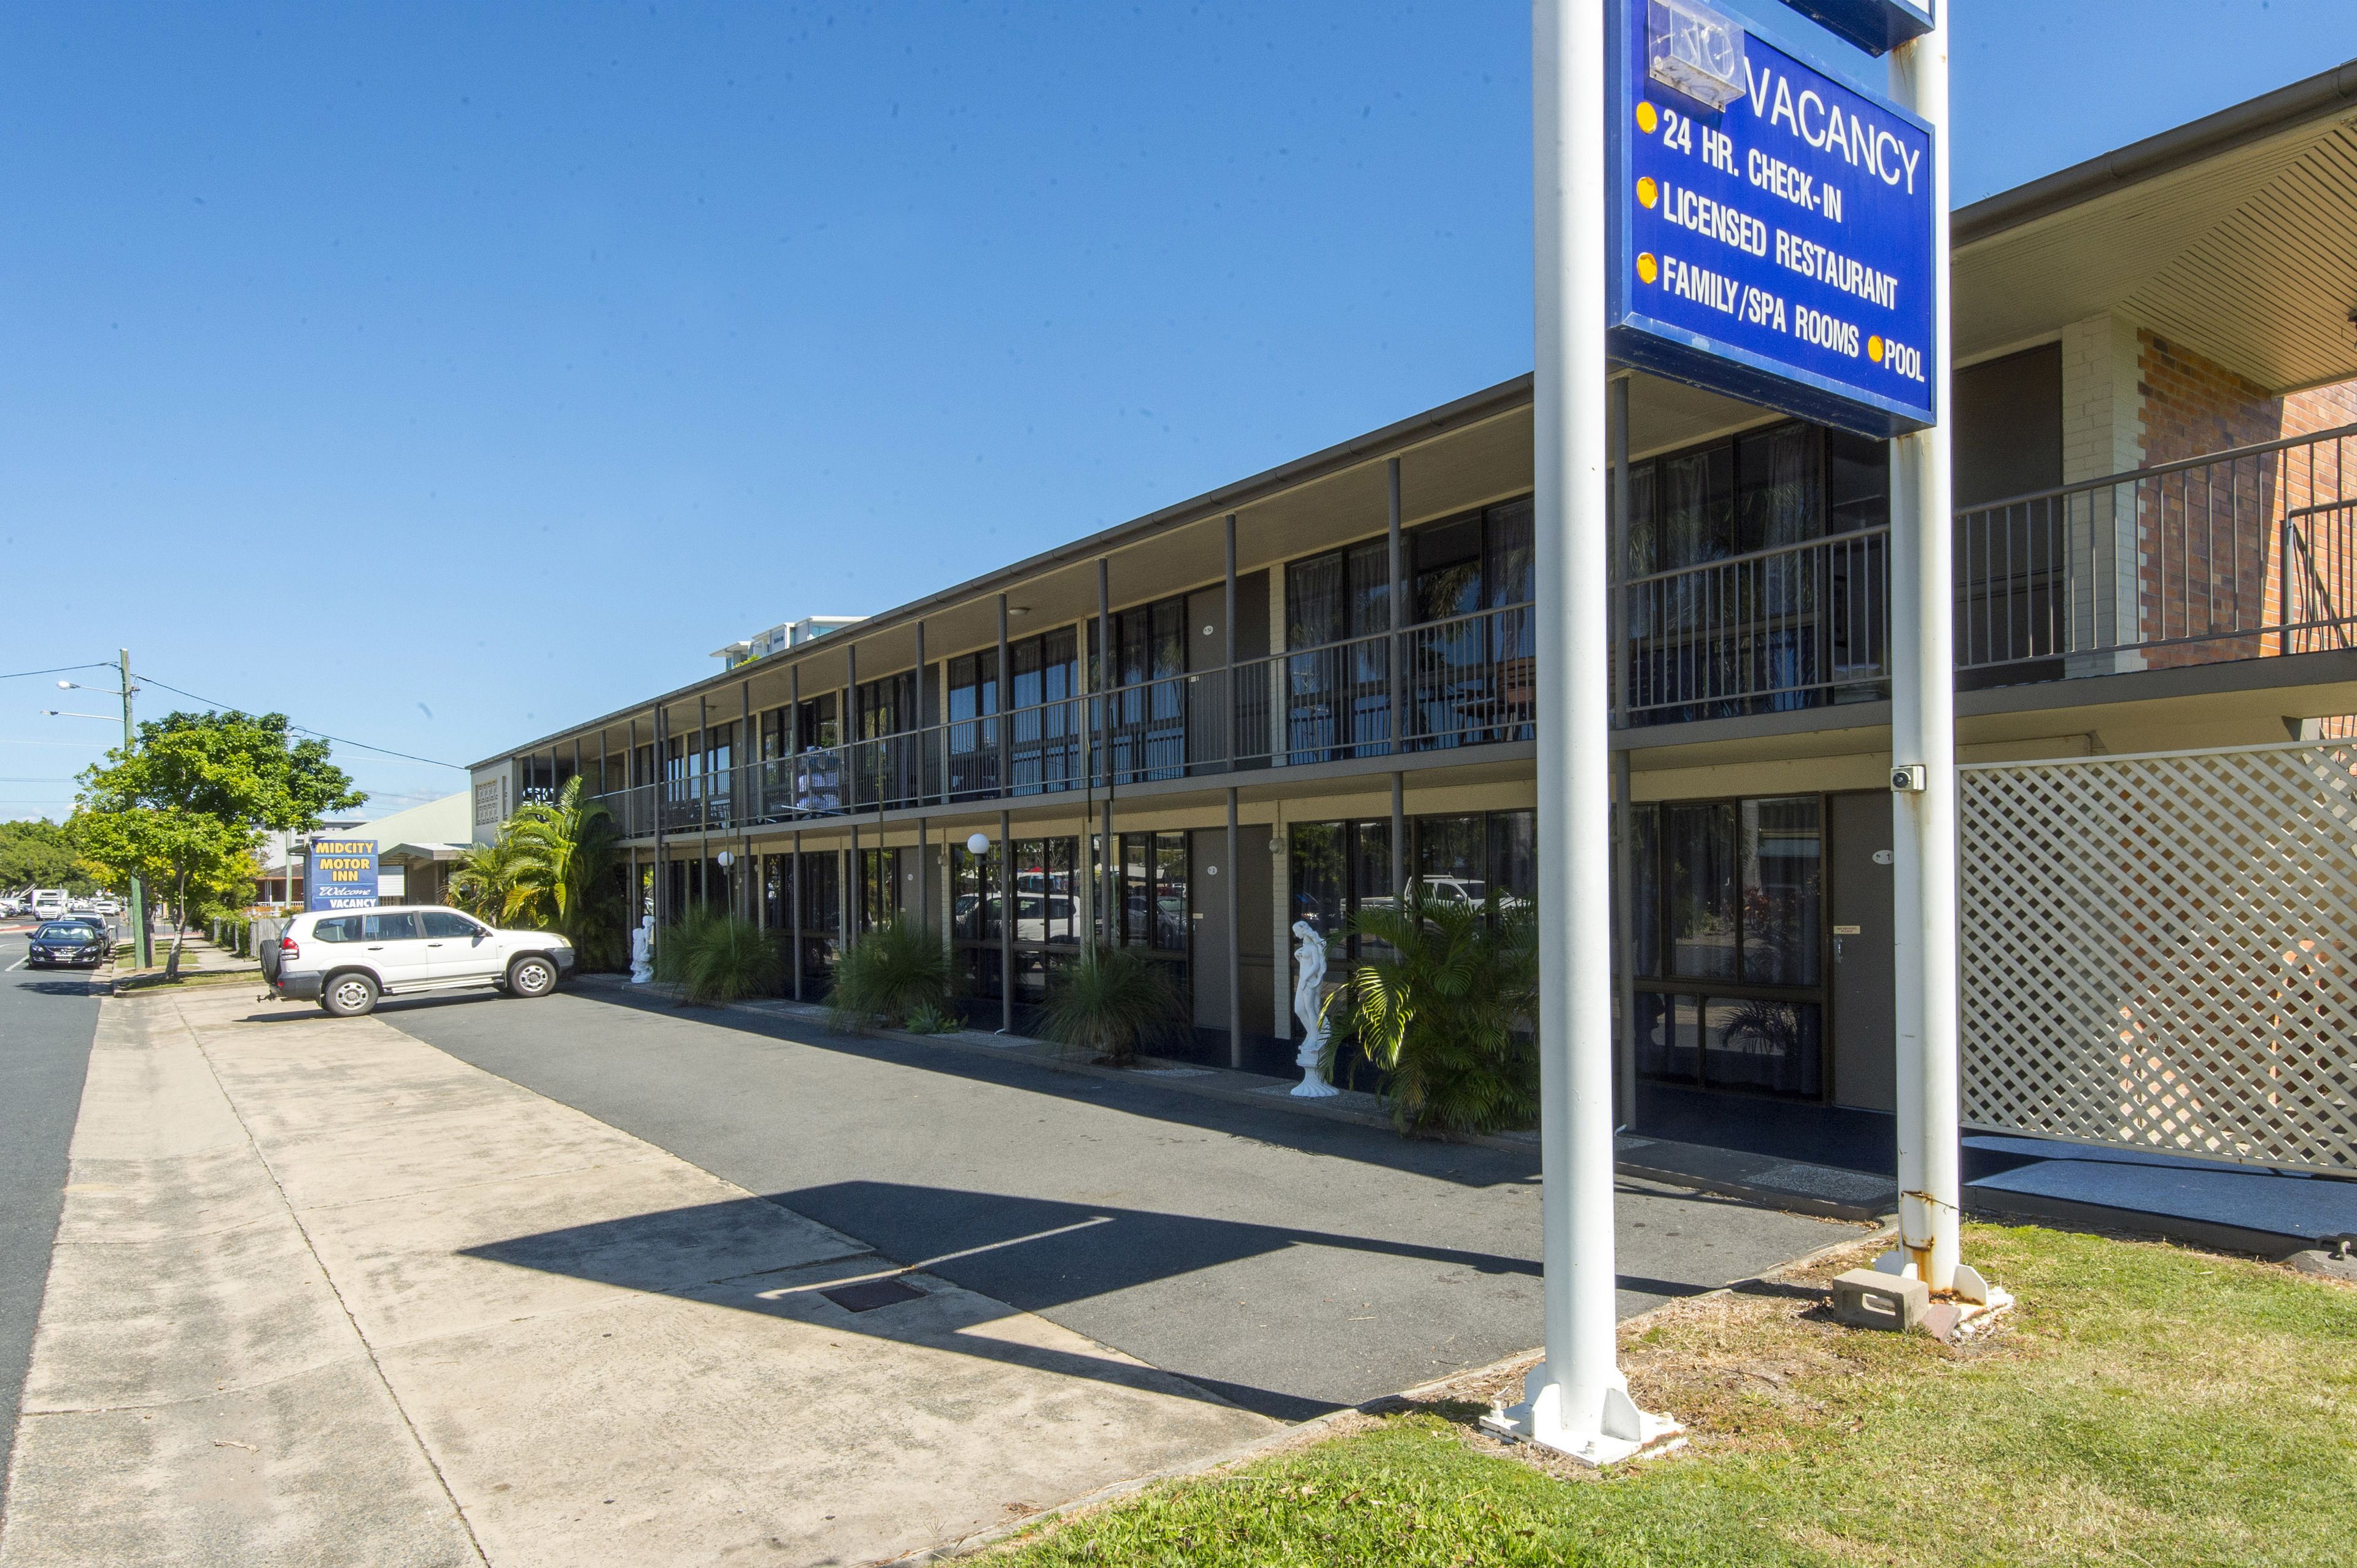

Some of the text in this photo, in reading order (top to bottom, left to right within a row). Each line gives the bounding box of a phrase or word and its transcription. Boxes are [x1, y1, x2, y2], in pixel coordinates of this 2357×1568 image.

[1743, 56, 1921, 195] VACANCY
[1663, 109, 1842, 223] 24 HR. CHECK-IN
[1663, 182, 1898, 311] LICENSED RESTAURANT
[1663, 255, 1925, 383] FAMILY/SPA ROOMS POOL
[315, 842, 374, 854] MIDCITY
[319, 858, 371, 870] MOTOR
[332, 870, 358, 882] INN
[319, 886, 371, 897] Welcome
[330, 898, 376, 908] VACANCY
